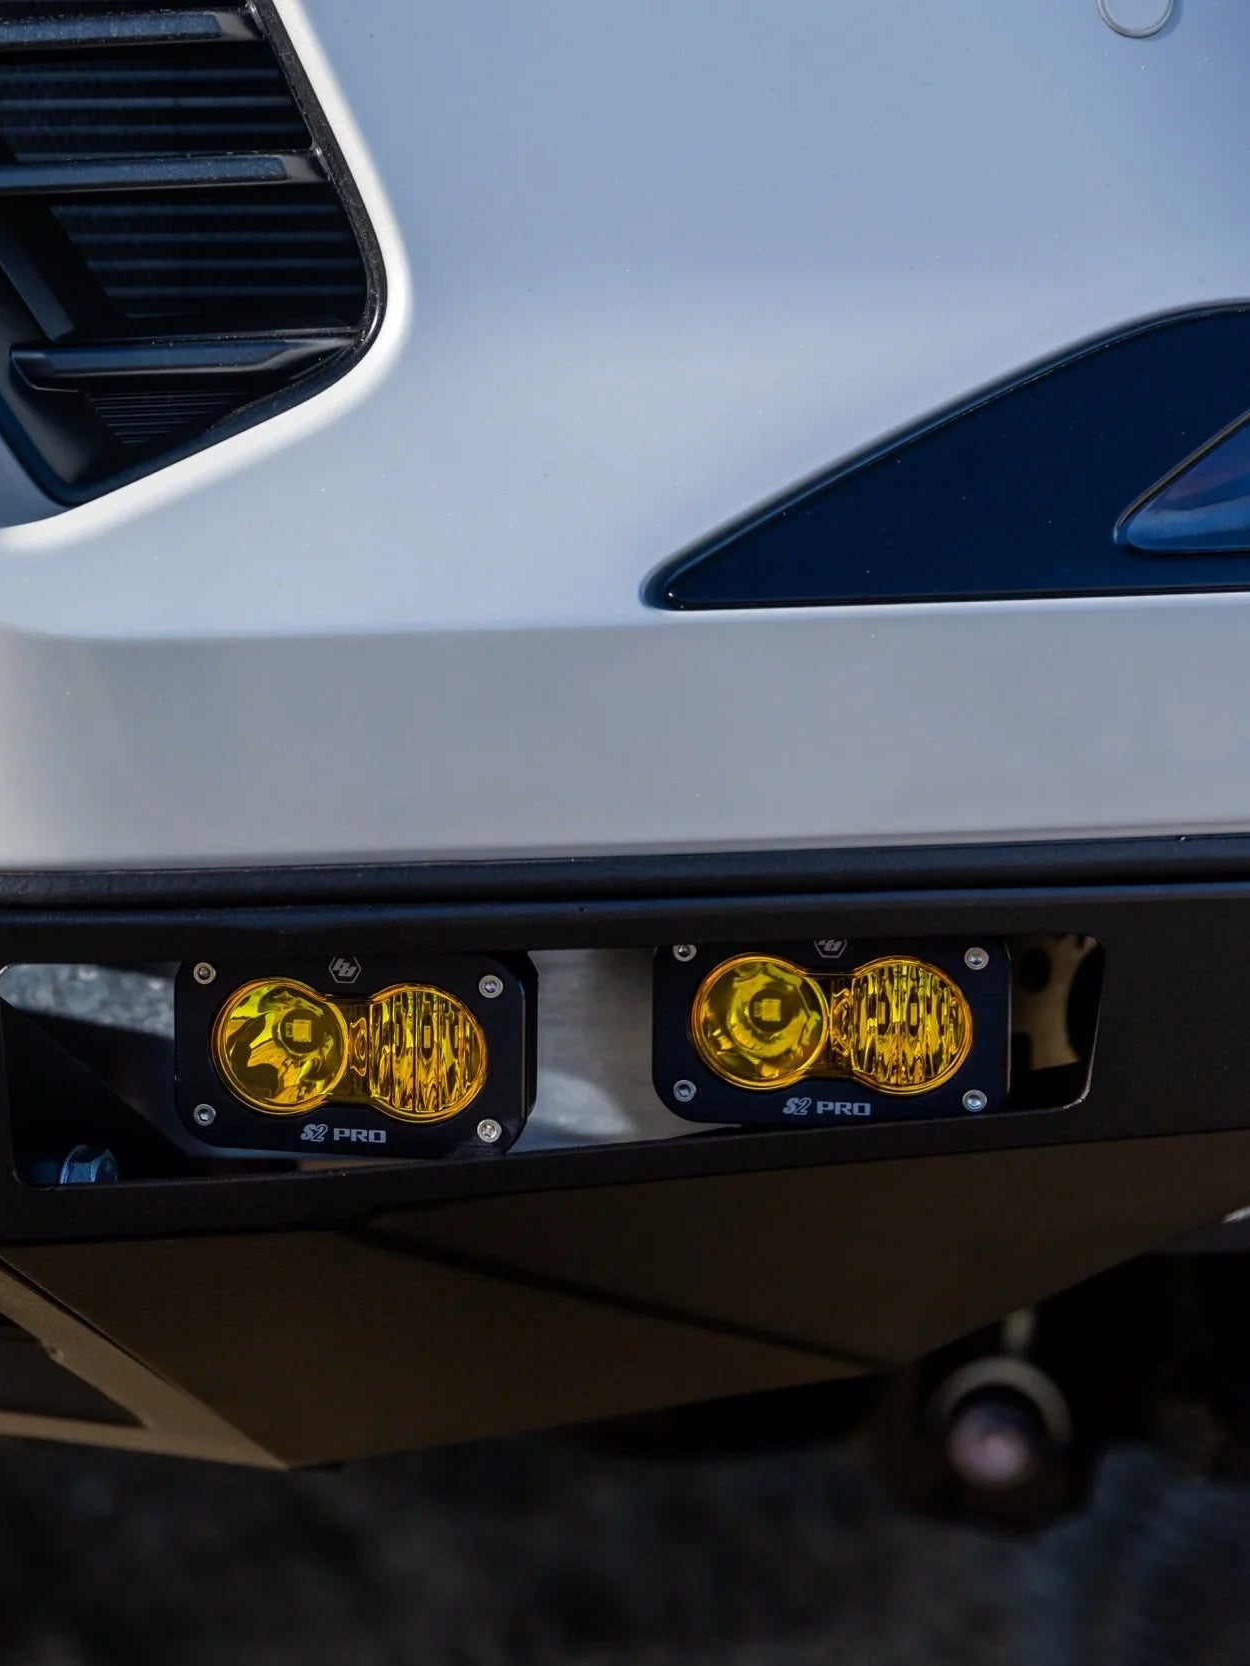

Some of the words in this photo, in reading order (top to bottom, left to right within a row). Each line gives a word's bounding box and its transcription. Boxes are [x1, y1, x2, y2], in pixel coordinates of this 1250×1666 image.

[782, 1097, 812, 1116] S2
[816, 1101, 871, 1116] PRO
[300, 1123, 329, 1142] S2
[333, 1127, 387, 1143] PRO
